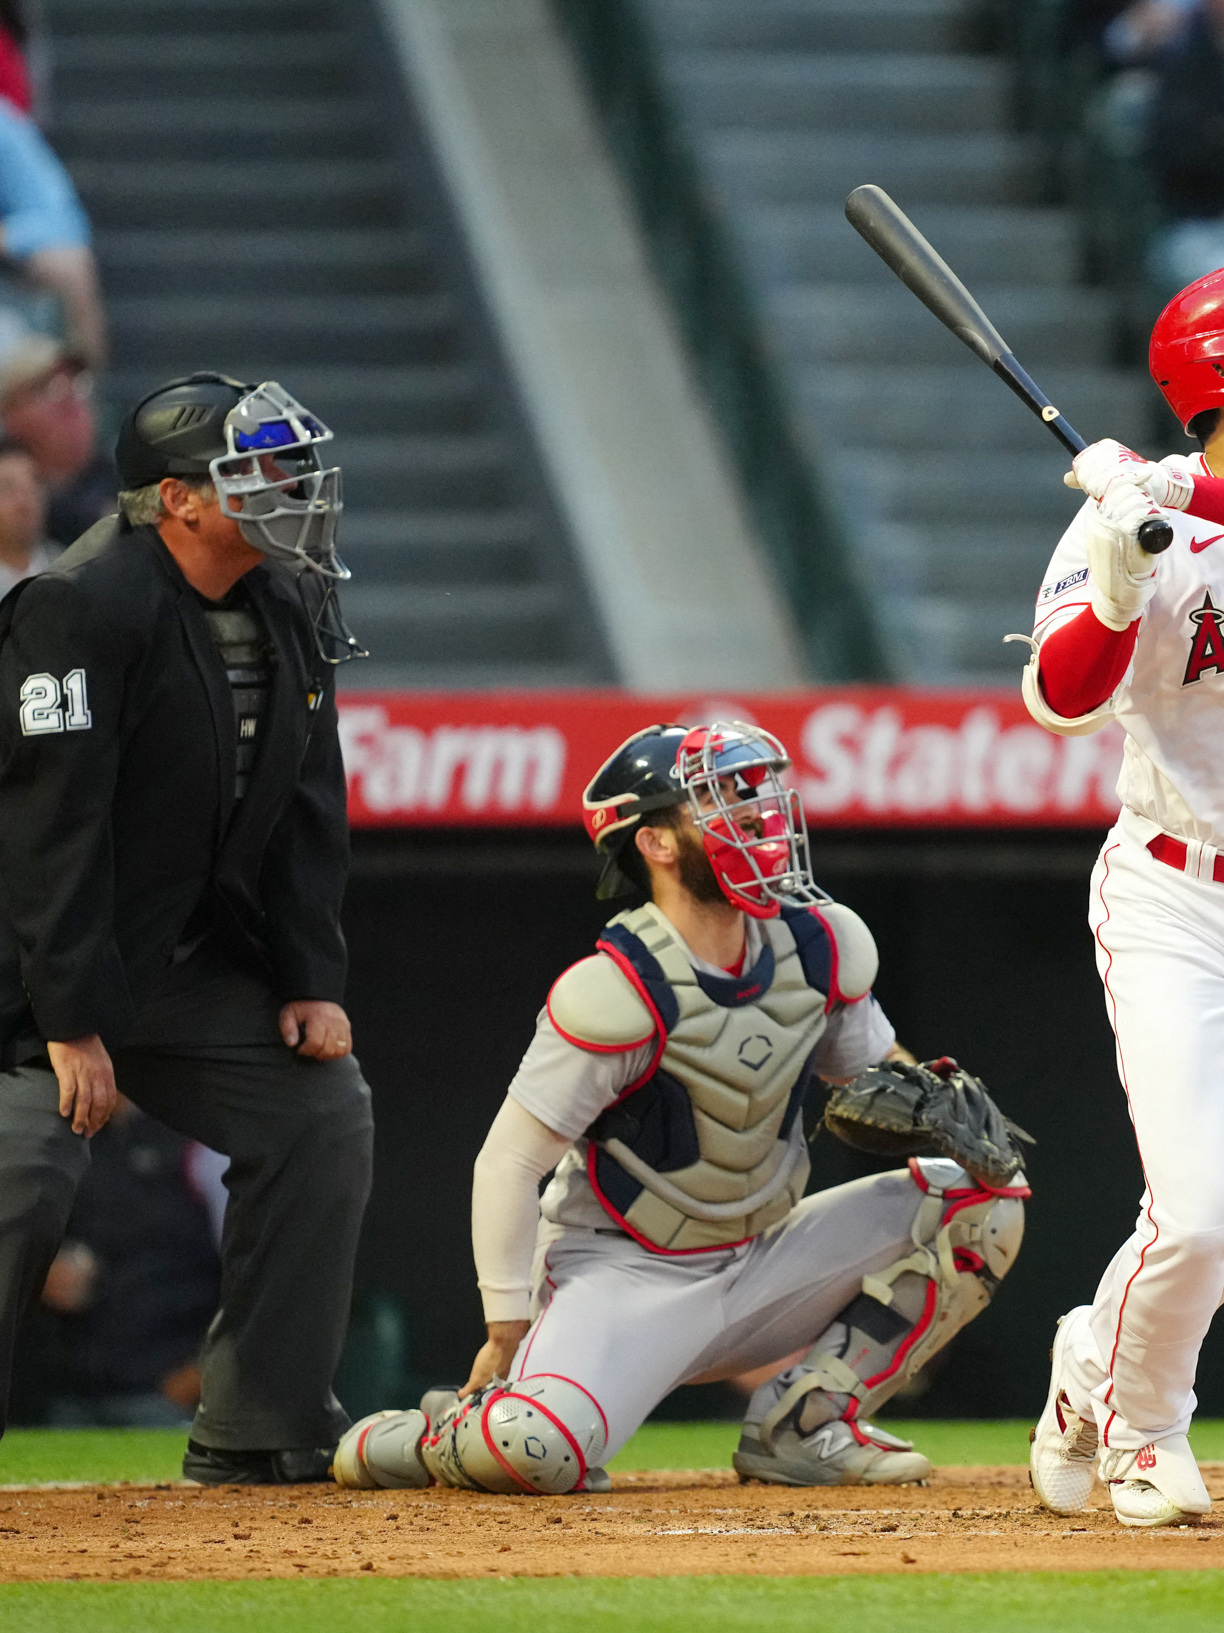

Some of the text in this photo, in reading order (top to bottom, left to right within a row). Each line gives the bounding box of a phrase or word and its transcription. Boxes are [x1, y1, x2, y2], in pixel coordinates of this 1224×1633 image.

[1057, 569, 1087, 592] FBM
[19, 668, 92, 736] 21
[240, 718, 257, 738] HW
